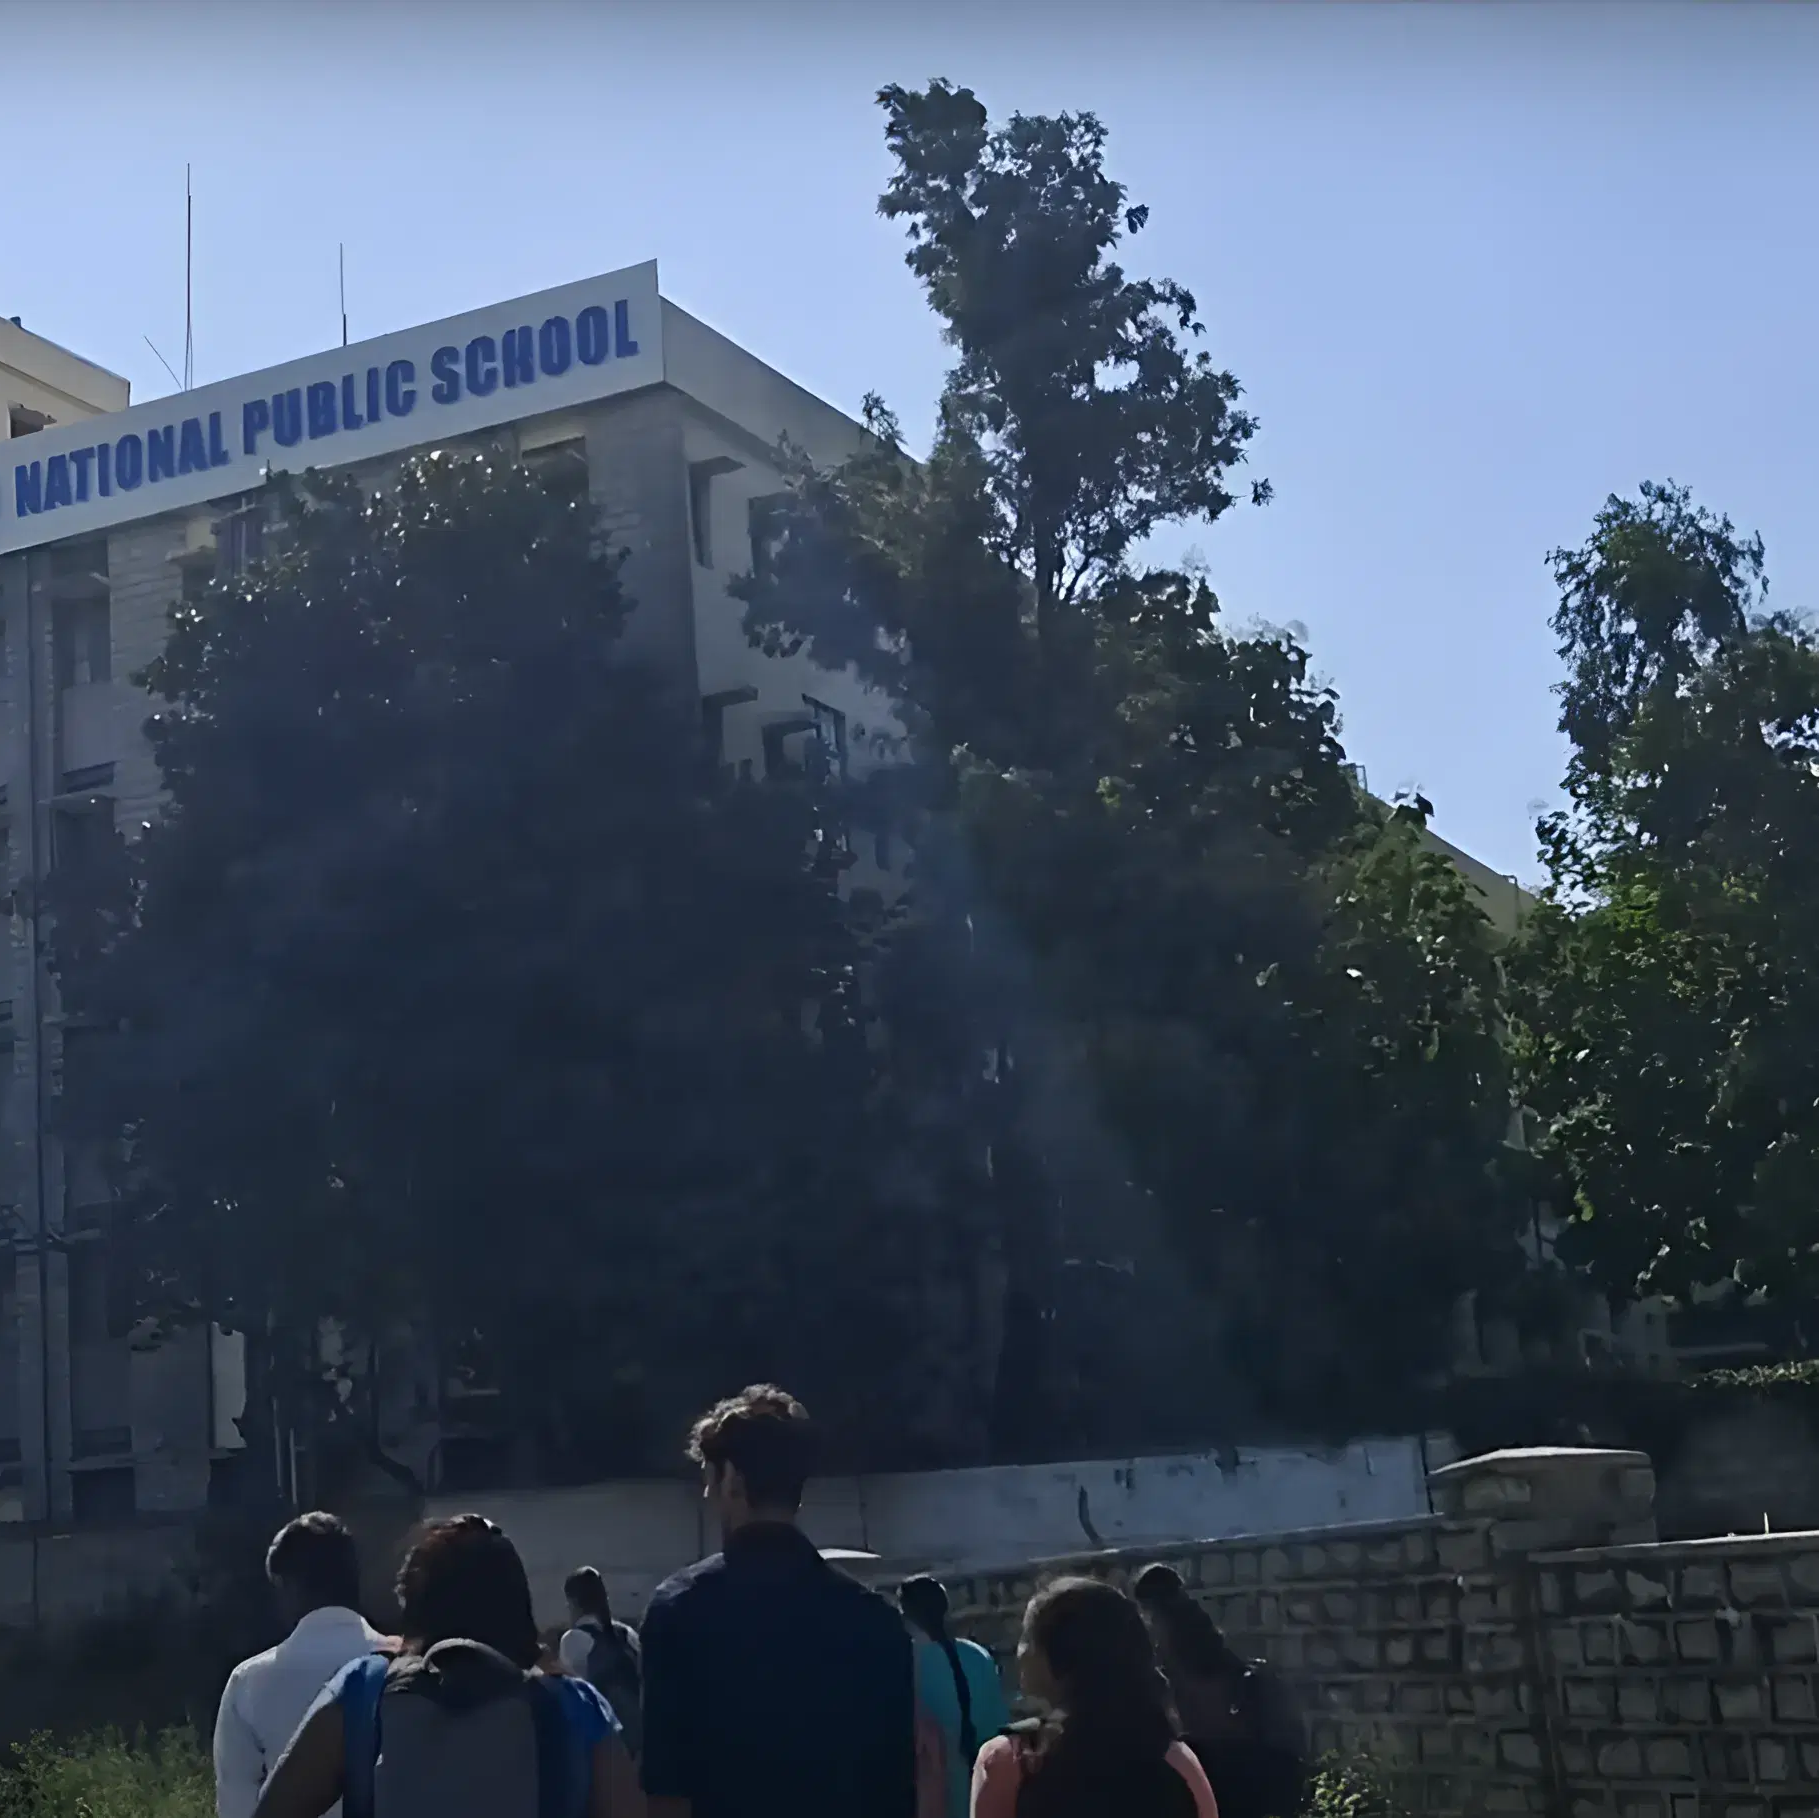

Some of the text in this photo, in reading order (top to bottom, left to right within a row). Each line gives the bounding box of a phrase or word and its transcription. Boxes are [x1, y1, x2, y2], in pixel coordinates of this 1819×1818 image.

[15, 299, 639, 518] NATIONAL PUBLIC SCHOOL
